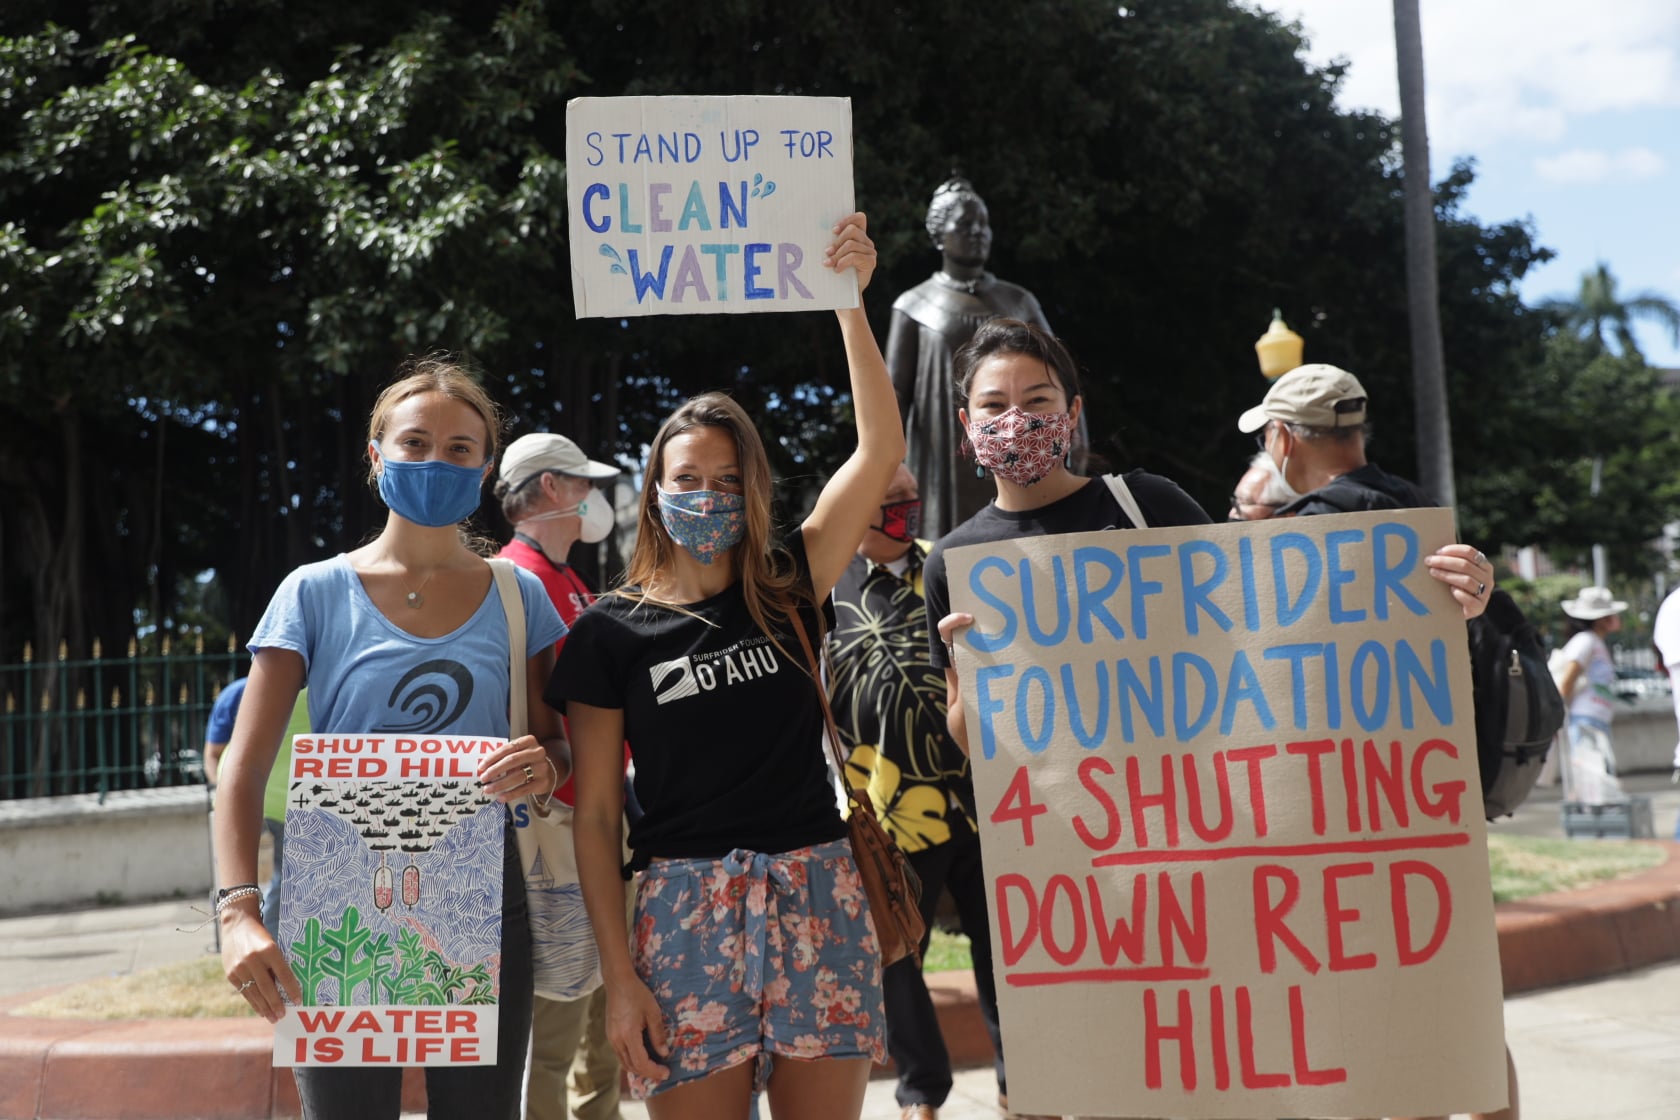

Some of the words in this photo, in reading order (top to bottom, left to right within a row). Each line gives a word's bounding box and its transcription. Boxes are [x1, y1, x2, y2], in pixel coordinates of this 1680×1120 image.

[587, 131, 702, 166] STAND
[720, 129, 760, 163] UP
[780, 130, 834, 159] FOR
[582, 180, 749, 234] CLEAN
[627, 243, 815, 305] WATER
[966, 522, 1430, 652] SURFRIDER
[692, 643, 740, 662] SURFRIDER
[975, 639, 1454, 760] FOUNDATION
[294, 738, 385, 754] SHUT
[395, 739, 504, 754] DOWN
[294, 758, 388, 778] RED
[990, 765, 1048, 847] 4
[1071, 738, 1467, 851] SHUTTING
[995, 871, 1208, 968] DOWN
[1252, 860, 1452, 975] RED
[297, 1010, 477, 1033] WATER
[1143, 985, 1347, 1093] HILL
[294, 1038, 344, 1063] IS
[361, 1037, 480, 1063] LIFE
